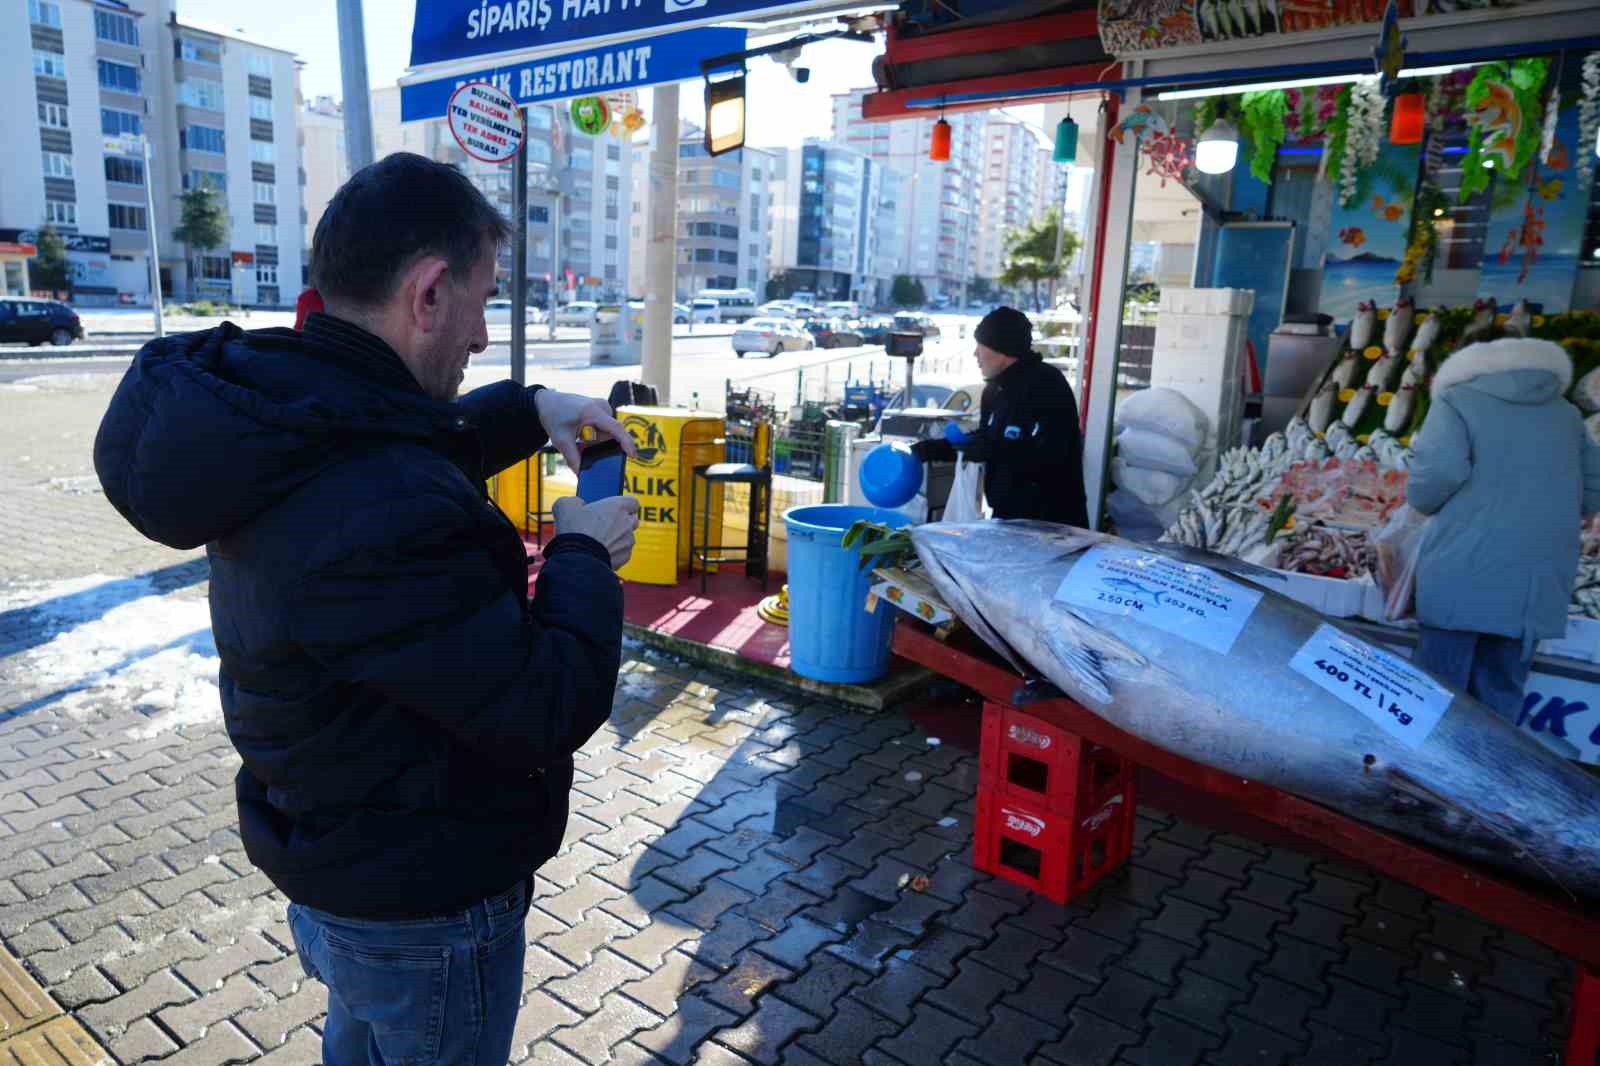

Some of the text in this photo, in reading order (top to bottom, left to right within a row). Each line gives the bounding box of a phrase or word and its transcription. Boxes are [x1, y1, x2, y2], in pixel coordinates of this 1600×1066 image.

[519, 45, 652, 98] RESTORANT
[1313, 659, 1350, 683] 400
[1353, 679, 1373, 700] TL
[1388, 702, 1414, 727] kg
